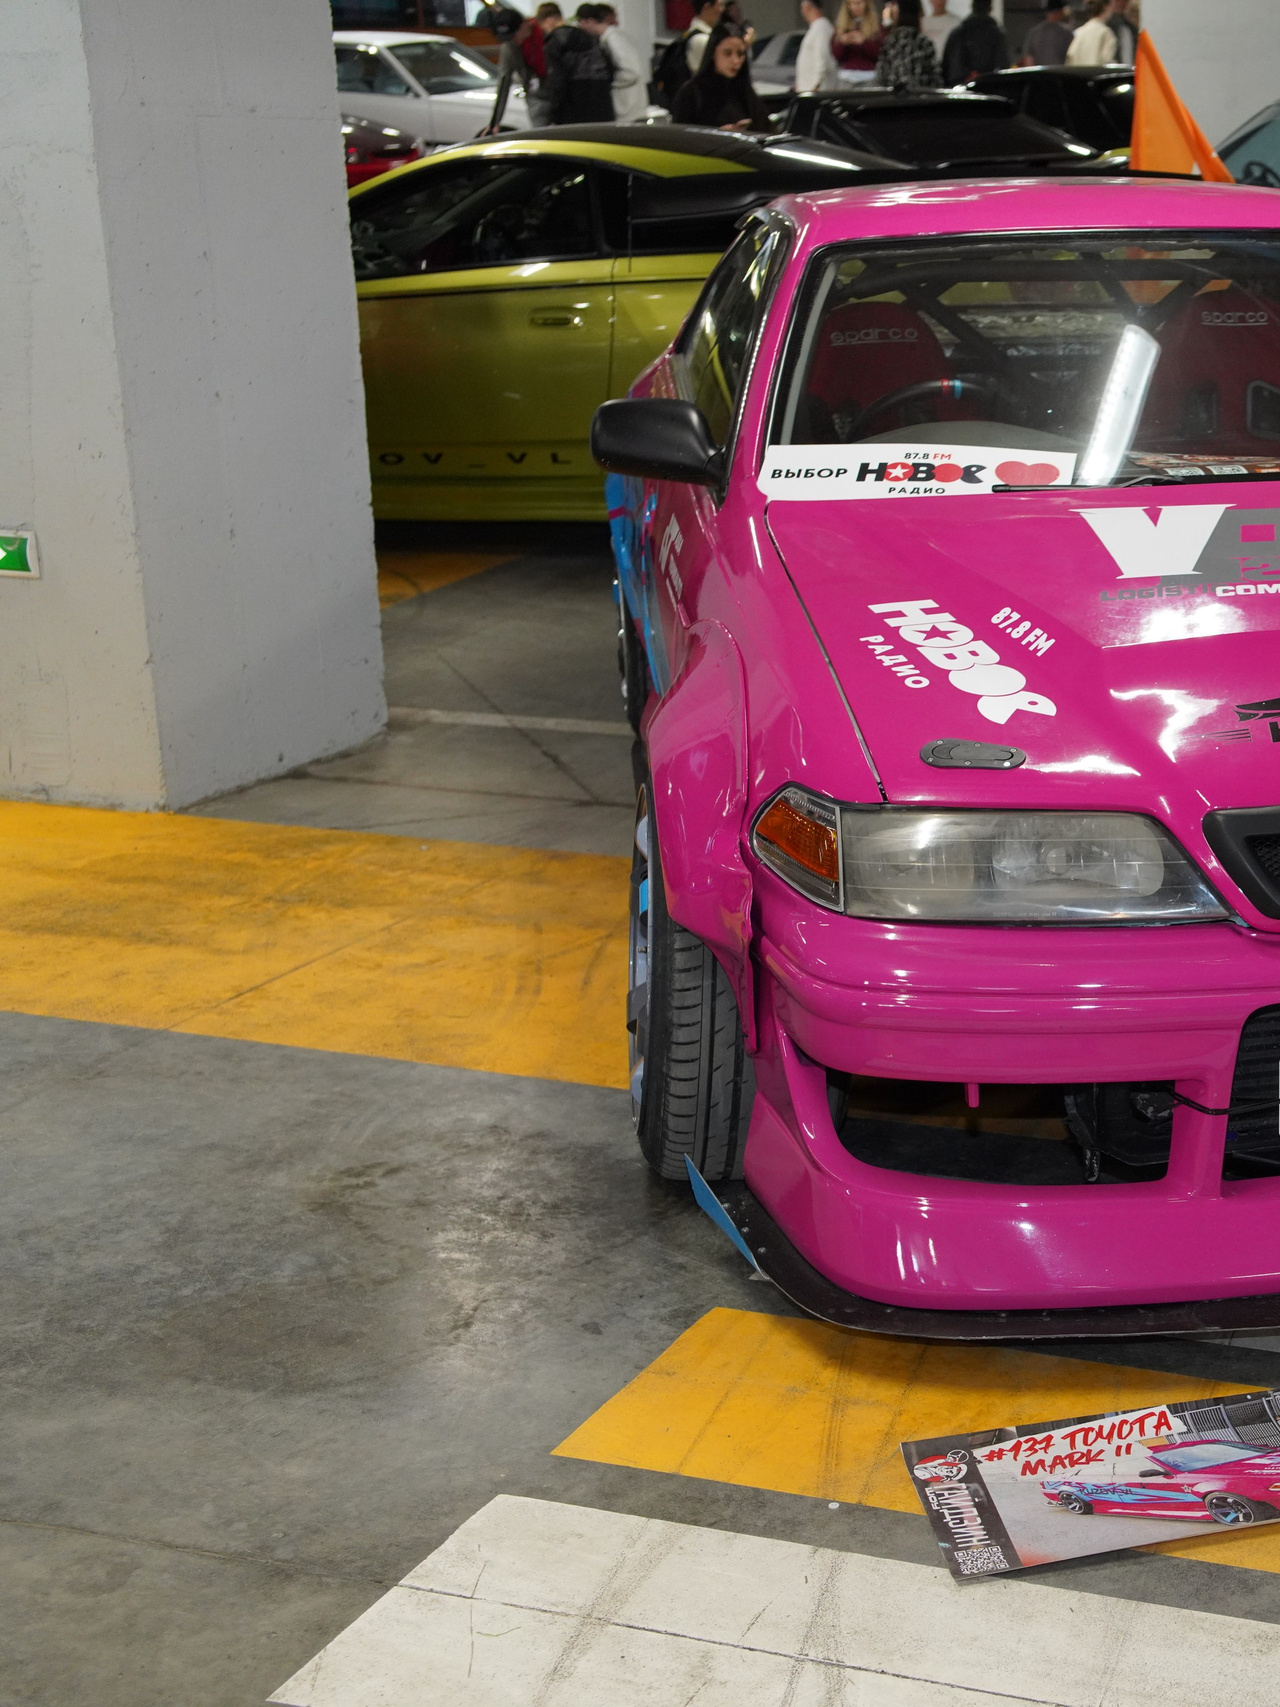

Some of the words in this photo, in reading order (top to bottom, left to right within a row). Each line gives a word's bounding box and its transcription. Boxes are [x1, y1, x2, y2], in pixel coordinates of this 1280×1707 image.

[771, 468, 848, 479] ВЫБОР
[888, 487, 945, 495] РАДИО
[991, 607, 1032, 639] 87.8
[1021, 628, 1056, 657] FM
[859, 635, 930, 689] РАДИО
[981, 1435, 1055, 1462] #137
[1061, 1410, 1172, 1450] TOYOTA
[1021, 1449, 1104, 1476] MARK
[925, 1486, 940, 1510] ШОУ
[932, 1482, 991, 1548] ГАЙДЗИН
